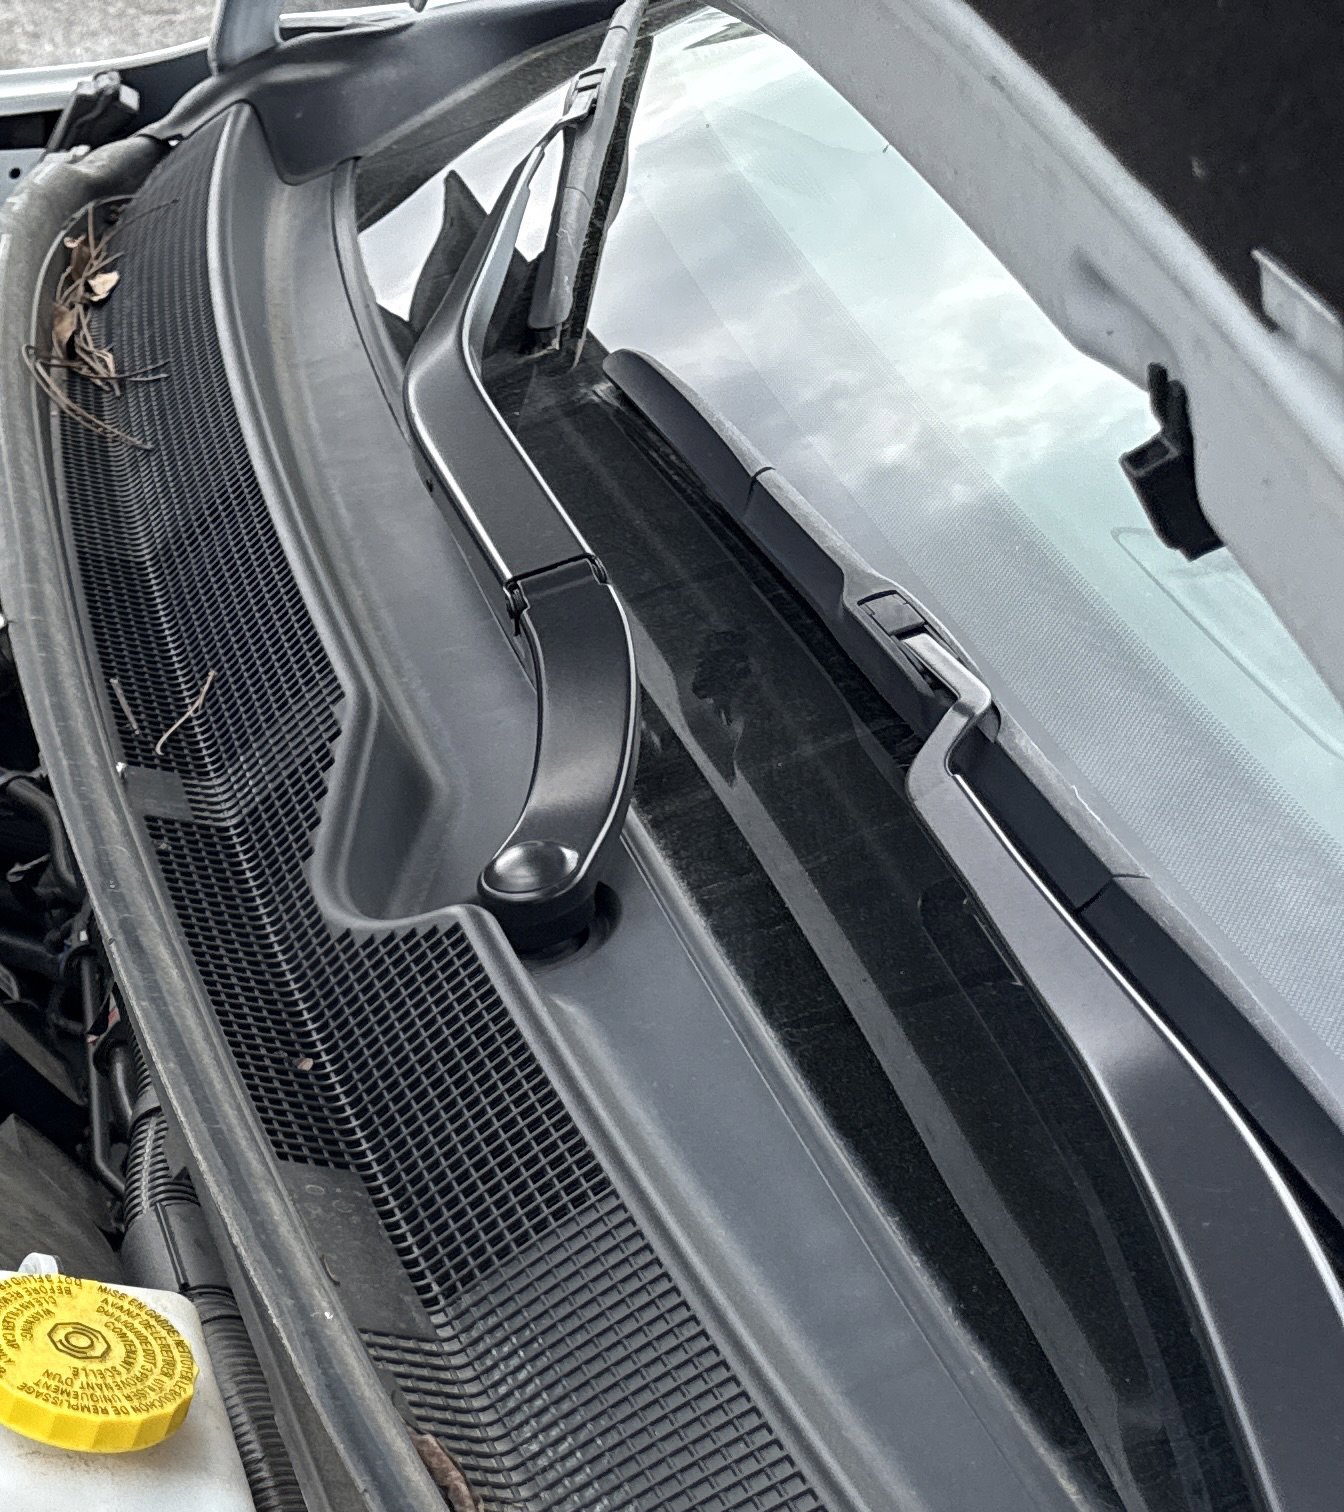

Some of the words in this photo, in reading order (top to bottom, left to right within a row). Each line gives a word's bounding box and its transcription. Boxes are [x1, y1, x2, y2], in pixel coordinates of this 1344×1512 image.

[11, 1274, 45, 1286] FLUID
[56, 1276, 82, 1288] DOT
[22, 1285, 72, 1297] BEFORE
[98, 1285, 127, 1300] MISE
[20, 1295, 57, 1311] CLEAN
[101, 1298, 141, 1319] AVANT
[128, 1299, 145, 1311] EN
[2, 1332, 20, 1350] CAP
[42, 1369, 73, 1386] D'UN
[79, 1371, 148, 1392] PROVENANT
[17, 1382, 109, 1414] REMPLISSAGE
[33, 1379, 121, 1404] UNIQUEMENT
[111, 1406, 130, 1415] DE
